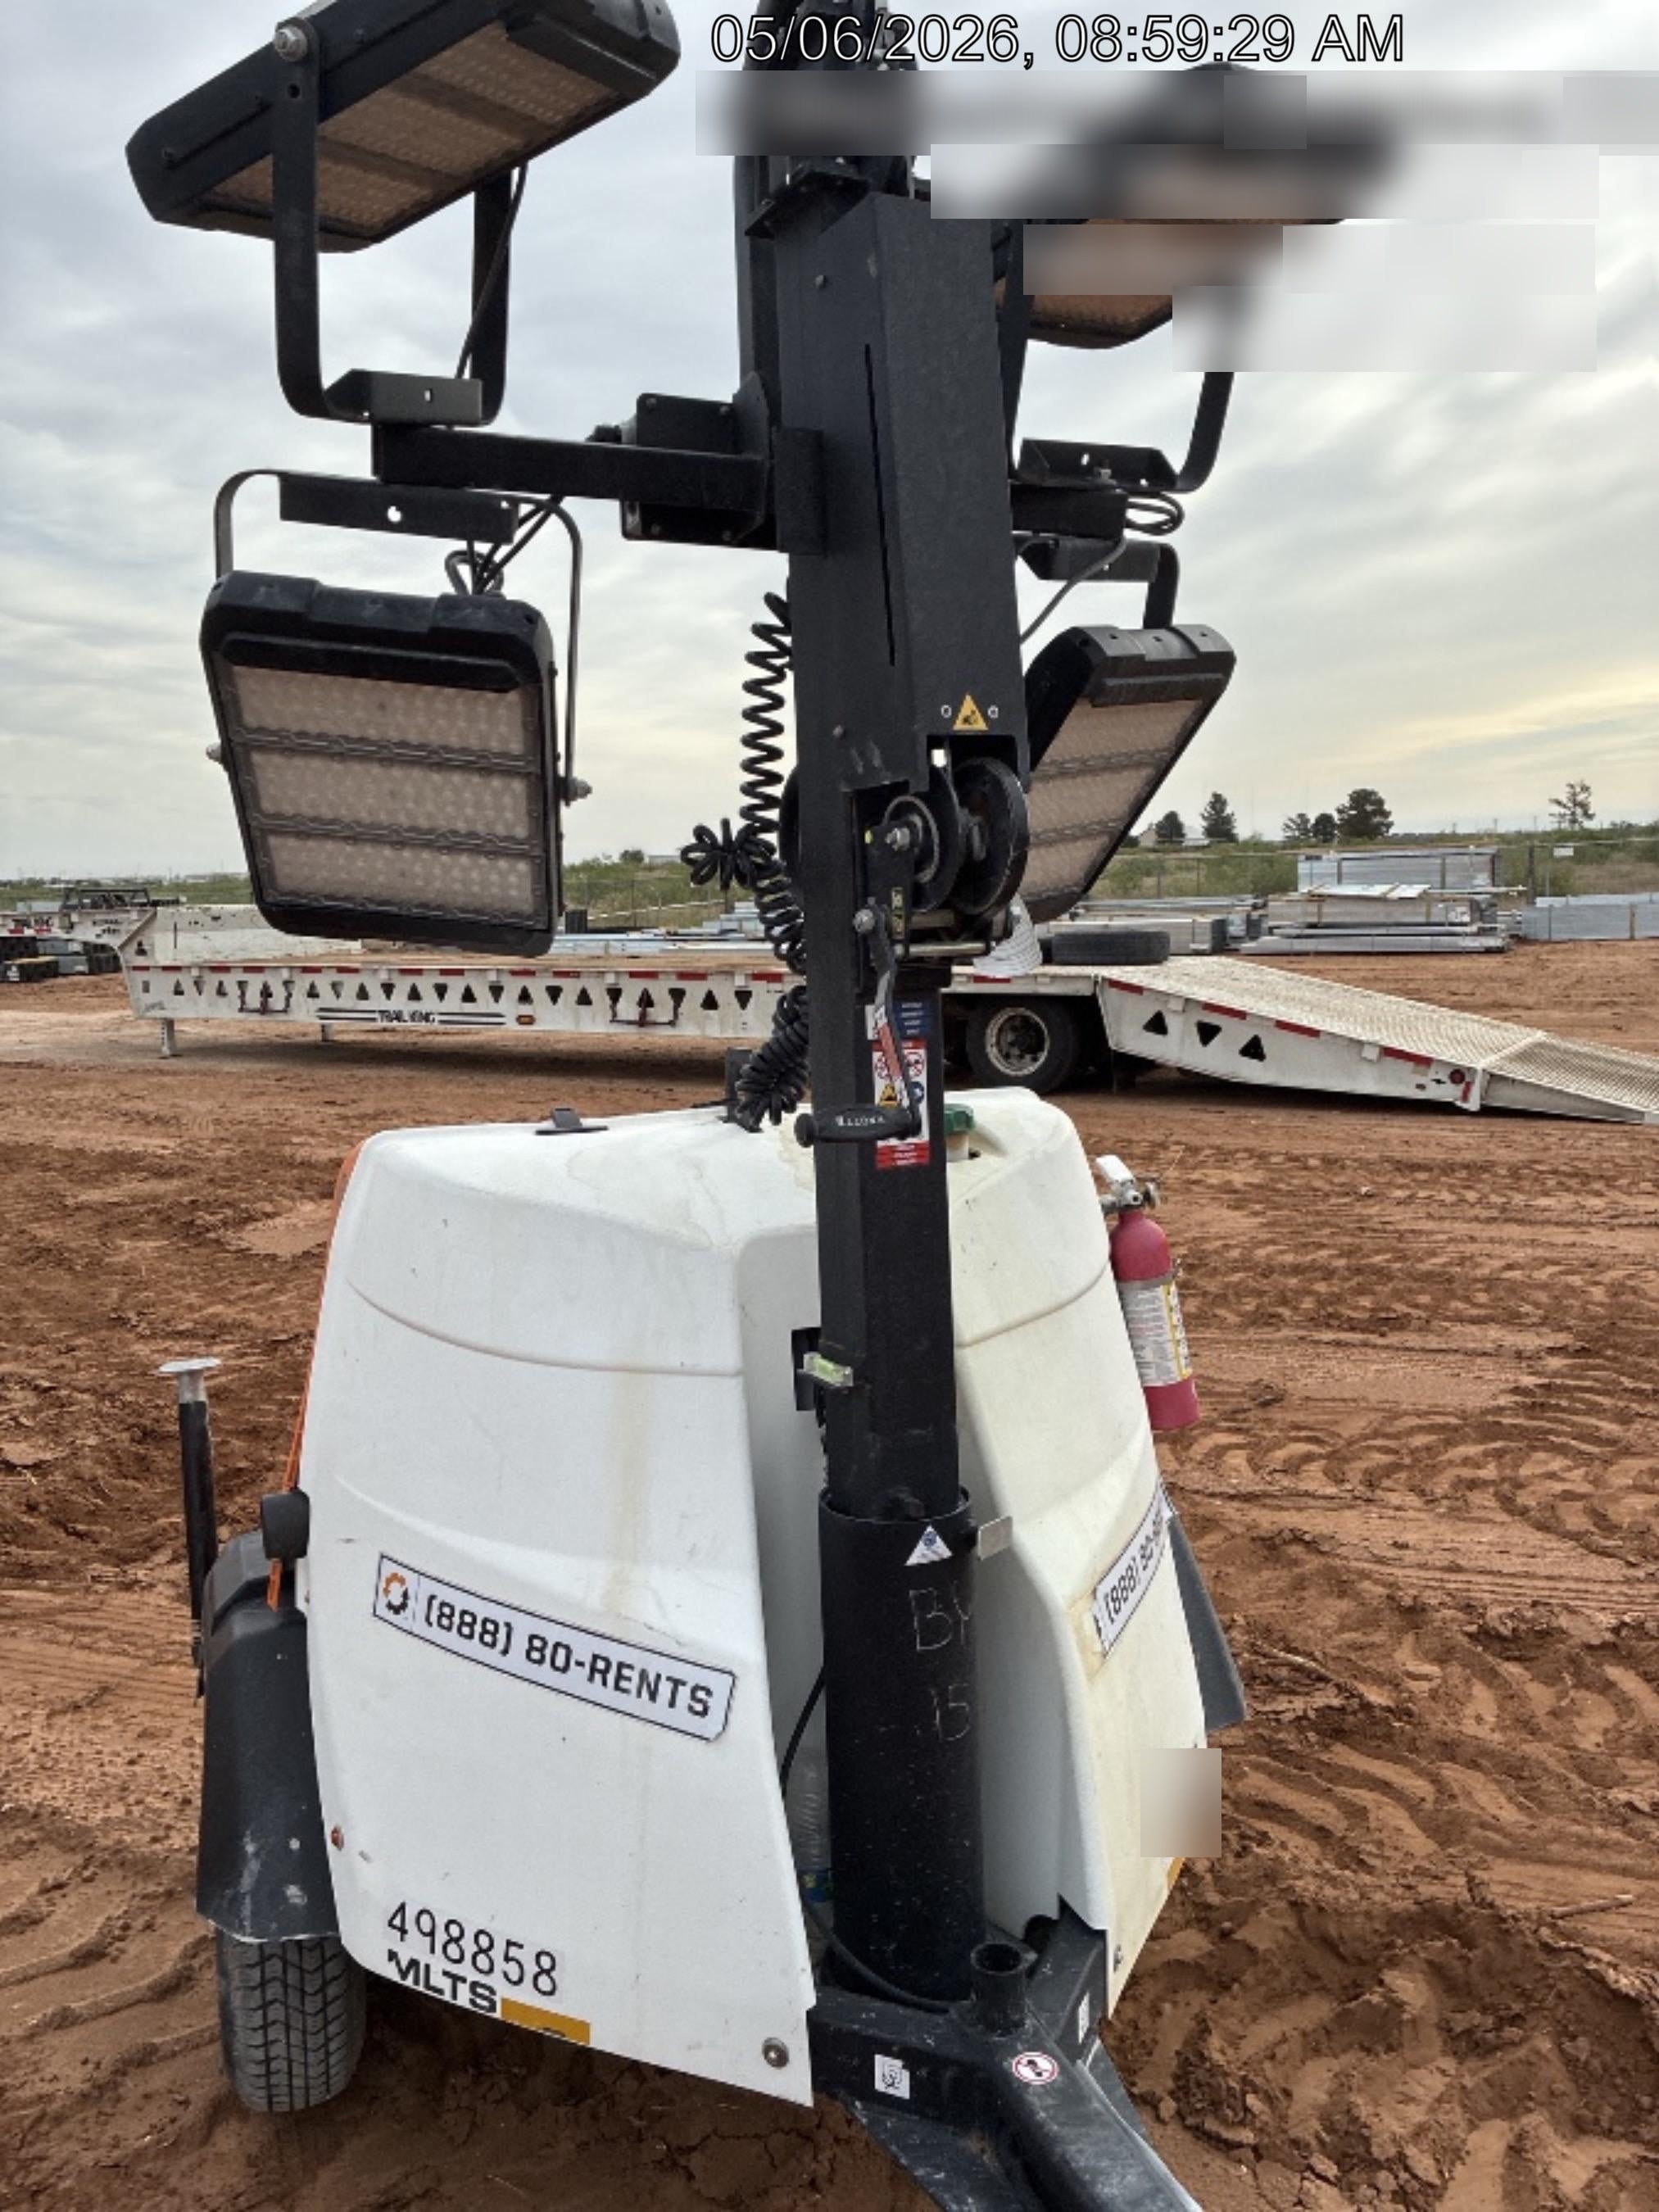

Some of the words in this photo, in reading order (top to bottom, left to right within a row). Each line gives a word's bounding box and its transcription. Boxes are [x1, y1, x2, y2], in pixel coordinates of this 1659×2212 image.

[424, 1593, 514, 1657] (888)
[525, 1633, 714, 1719] 80-RENTS
[387, 1901, 557, 1997] 498858
[388, 1948, 497, 2014] MLTS
